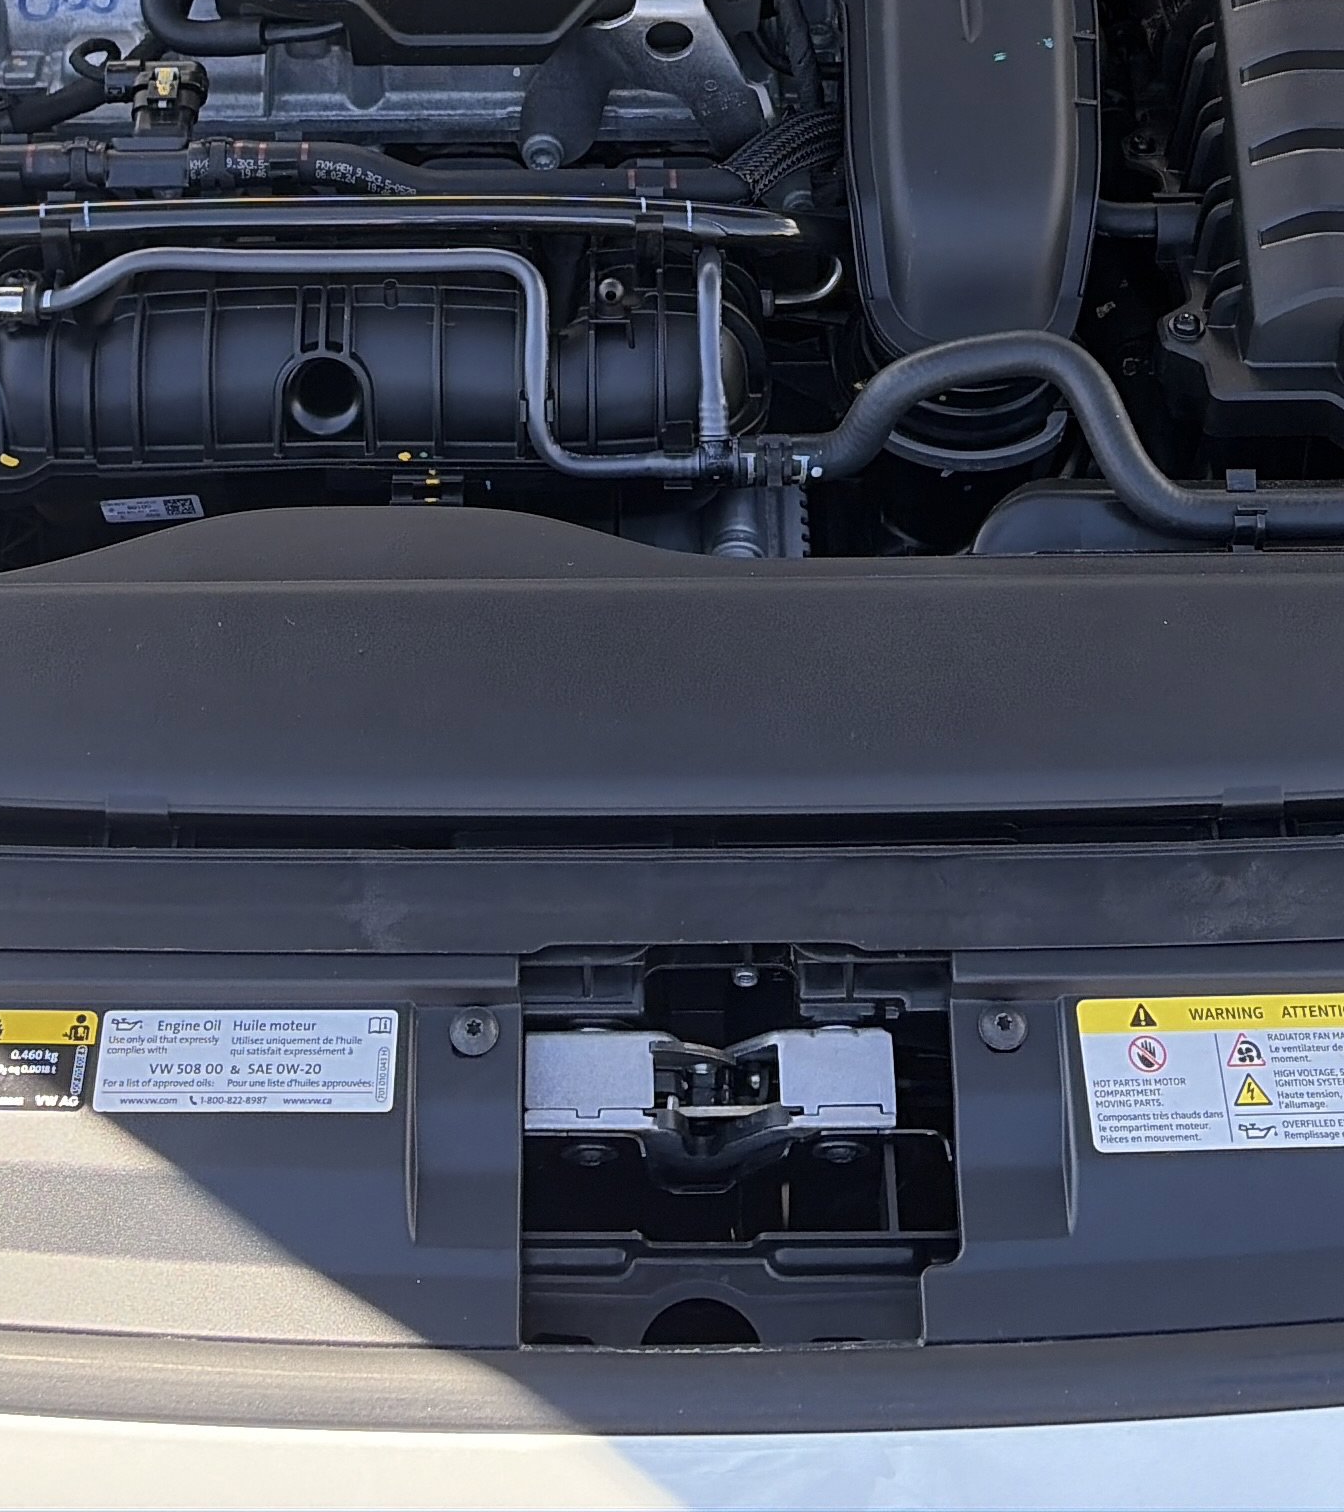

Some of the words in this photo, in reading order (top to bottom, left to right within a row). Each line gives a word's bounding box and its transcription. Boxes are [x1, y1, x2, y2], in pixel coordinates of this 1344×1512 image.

[1189, 1006, 1264, 1021] WARNING
[158, 1020, 200, 1034] Engine
[204, 1020, 221, 1031] Oil
[233, 1020, 266, 1031] Huile
[269, 1020, 317, 1031] moteur
[108, 1035, 126, 1044] Use
[126, 1035, 144, 1046] only
[147, 1035, 156, 1044] oil
[159, 1035, 177, 1044] that
[179, 1035, 219, 1046] expressly
[231, 1036, 264, 1045] Utilisez
[266, 1037, 320, 1047] uniquement
[323, 1036, 333, 1045] de
[1267, 1032, 1311, 1041] RADIATOR
[1313, 1031, 1330, 1040] FAN
[107, 1047, 145, 1056] complies
[147, 1046, 168, 1055] with
[230, 1047, 244, 1057] qui
[246, 1047, 281, 1056] satisfait
[283, 1047, 346, 1057] expressément
[1269, 1044, 1280, 1054] Le
[1282, 1043, 1330, 1053] ventilateur
[1332, 1042, 1343, 1052] de
[45, 1049, 59, 1063] kg
[1271, 1054, 1312, 1063] moment.
[149, 1063, 174, 1075] VW
[177, 1063, 201, 1075] 508
[205, 1063, 223, 1075] 00
[230, 1064, 240, 1075] &
[248, 1063, 273, 1075] SAE
[276, 1063, 322, 1075] 0W-20
[1273, 1069, 1295, 1078] HIGH
[103, 1079, 116, 1088] For
[126, 1078, 139, 1088] list
[141, 1078, 152, 1088] of
[153, 1078, 194, 1089] approved
[196, 1078, 215, 1088] oils:
[227, 1079, 247, 1087] Pour
[249, 1079, 266, 1087] une
[267, 1078, 285, 1088] liste
[1093, 1079, 1111, 1088] HOT
[1113, 1078, 1141, 1088] PARTS
[1142, 1078, 1152, 1086] IN
[1154, 1077, 1186, 1087] MOTOR
[1275, 1078, 1315, 1087] IGNITION
[1277, 1090, 1304, 1099] Haute
[1306, 1089, 1343, 1100] tension,
[35, 1095, 58, 1106] VW
[59, 1095, 79, 1107] AG
[120, 1096, 177, 1105] www.vw.com
[283, 1097, 332, 1105] www.vw.ca
[1096, 1099, 1132, 1108] MOVING
[1134, 1098, 1164, 1107] PARTS.
[1098, 1112, 1151, 1123] Composants
[1153, 1111, 1169, 1120] très
[1171, 1110, 1201, 1120] chauds
[1203, 1110, 1224, 1119] dans
[1099, 1124, 1107, 1133] le
[1109, 1123, 1174, 1133] compartiment
[1282, 1118, 1336, 1129] OVERFILLED
[1100, 1134, 1129, 1144] Pièces
[1131, 1135, 1142, 1143] en
[1144, 1133, 1202, 1143] mouvement.
[1284, 1129, 1340, 1140] Remplissage
